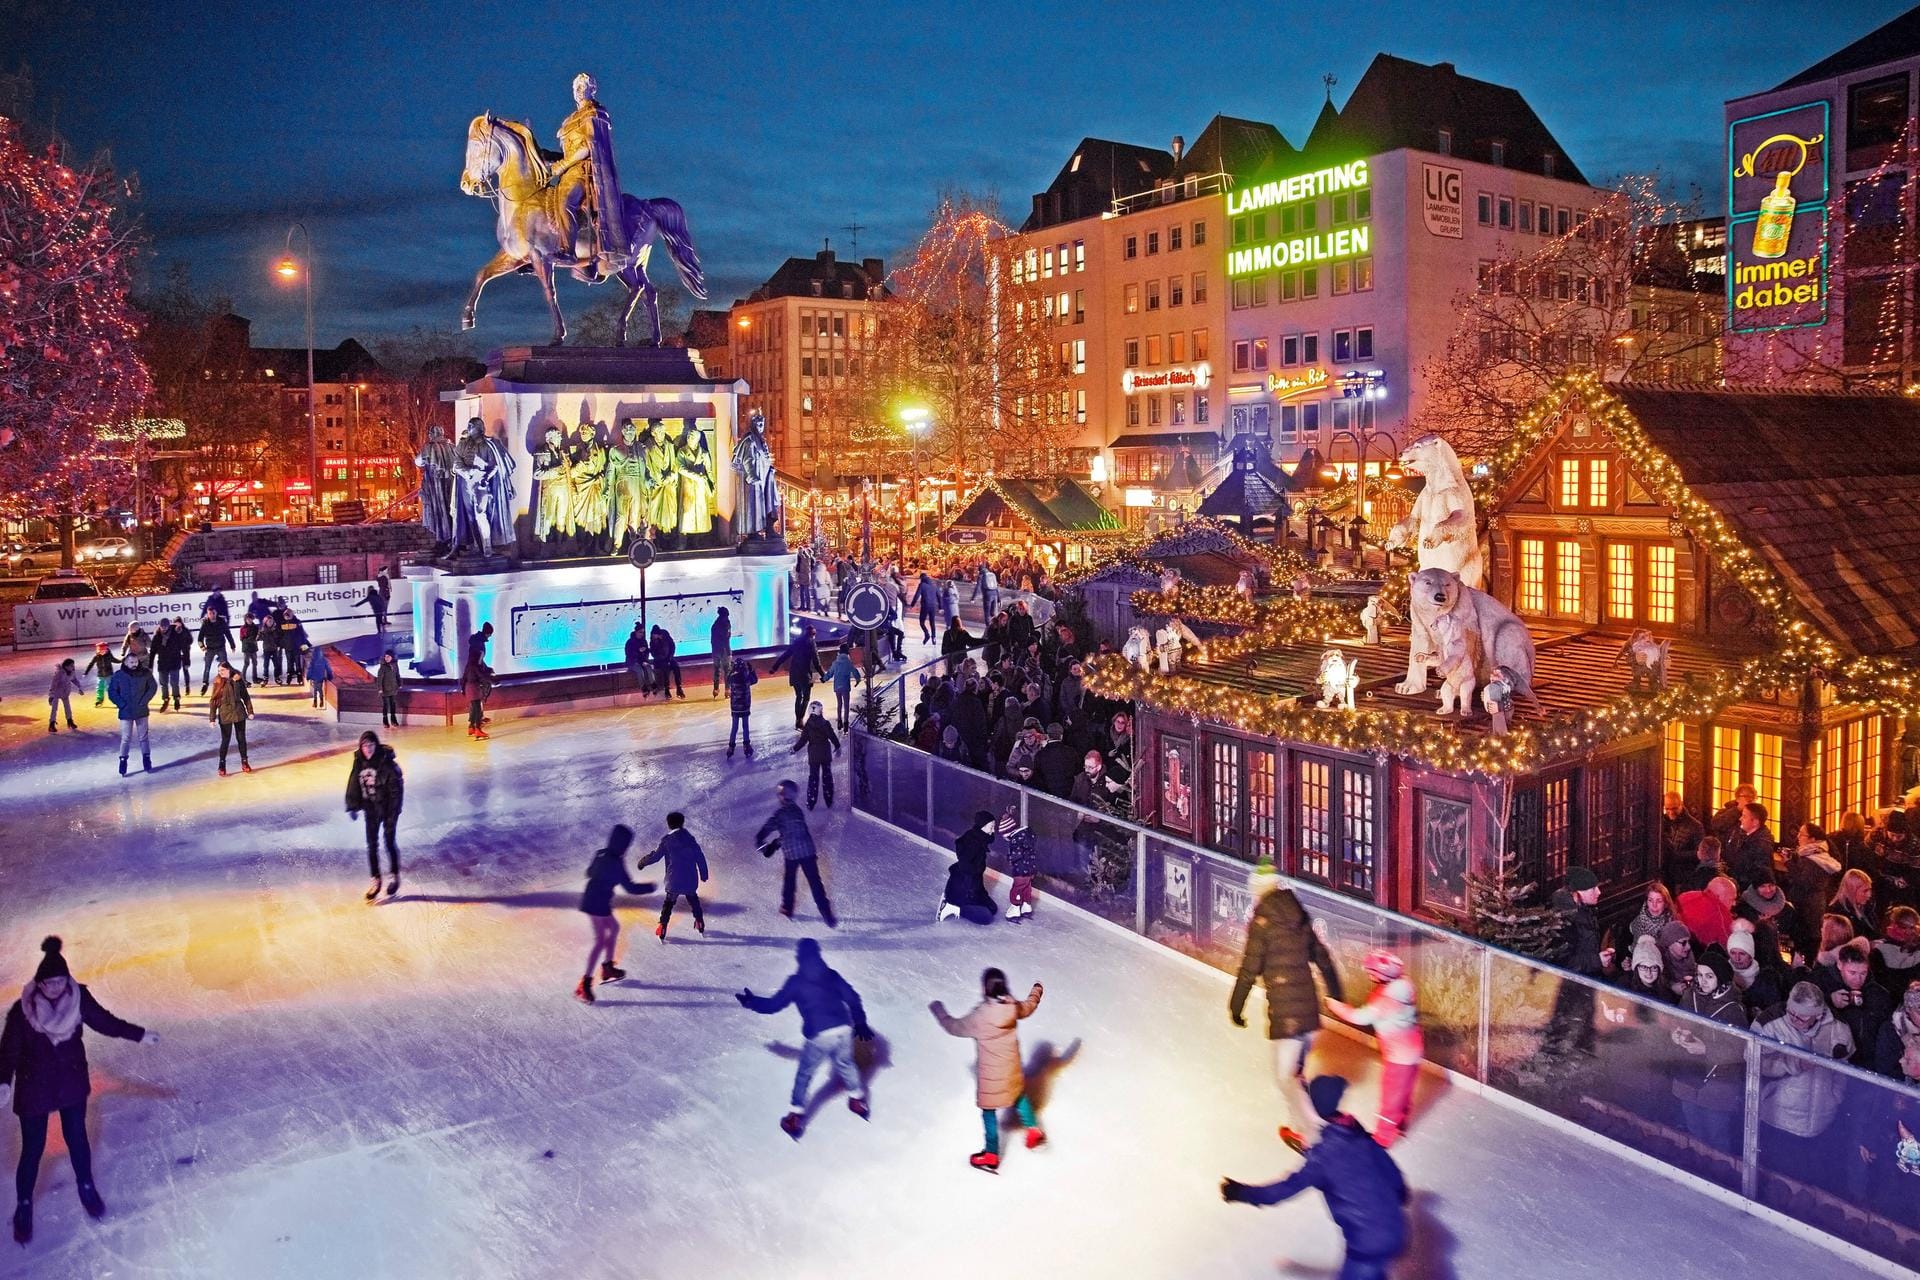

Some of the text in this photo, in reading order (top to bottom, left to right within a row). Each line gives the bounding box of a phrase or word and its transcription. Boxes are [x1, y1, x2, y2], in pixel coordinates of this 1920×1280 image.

[1227, 160, 1368, 216] LAMMERTING
[1426, 169, 1460, 204] LIG
[1426, 202, 1460, 216] LAMMERTING
[1431, 213, 1460, 225] IMMOBILIEN
[1440, 225, 1460, 235] GRUPPE
[1228, 226, 1369, 276] IMMOBILIEN
[1735, 256, 1820, 284] immer
[1736, 278, 1819, 309] dabei
[1134, 373, 1168, 387] Reissdorf
[1268, 368, 1328, 391] Bitte ein Bit
[57, 608, 89, 620] Wir
[97, 600, 192, 617] wünschen
[199, 598, 246, 610] een
[306, 587, 366, 602] Rutsch!
